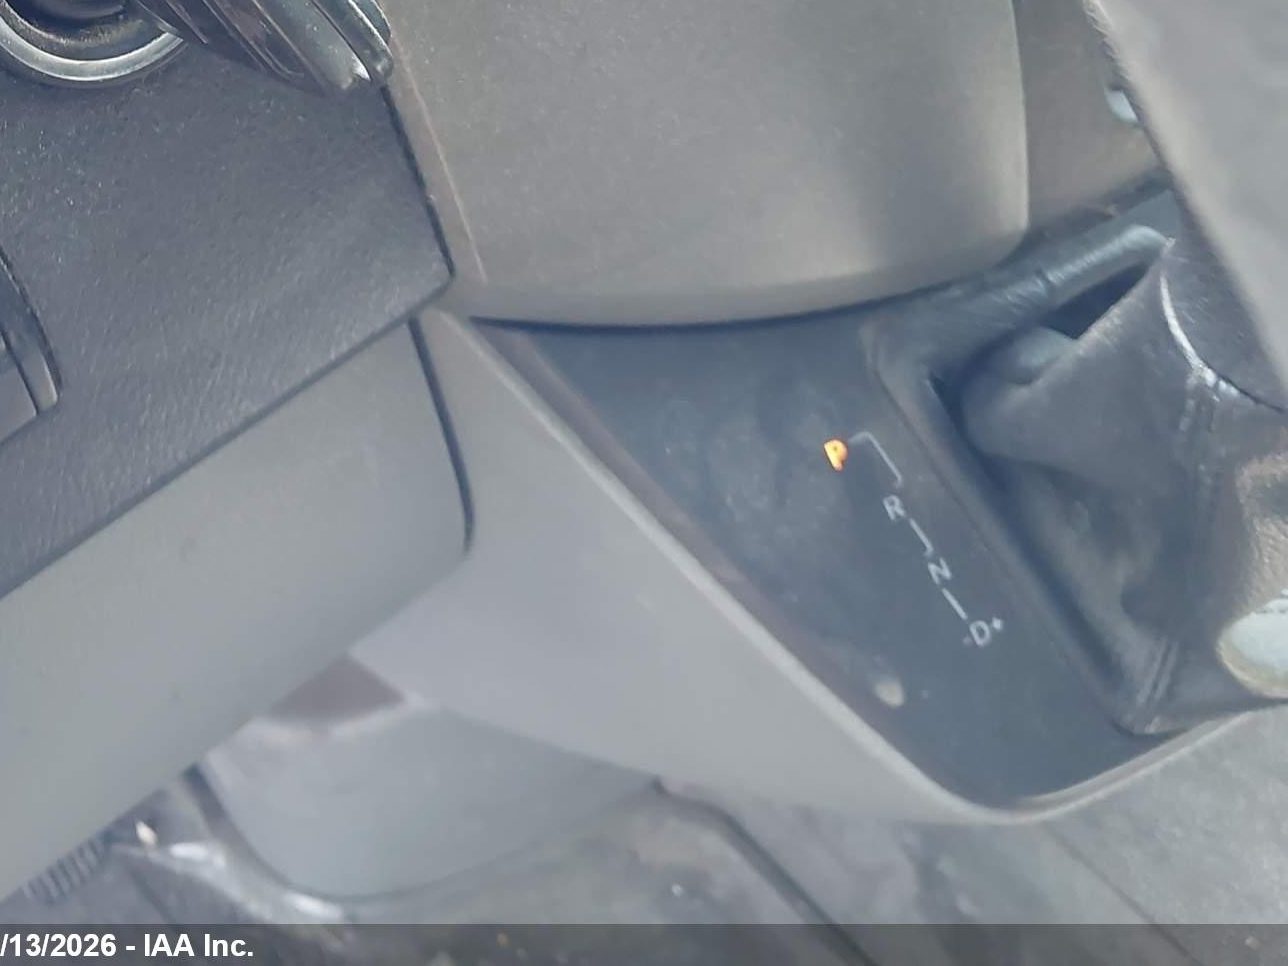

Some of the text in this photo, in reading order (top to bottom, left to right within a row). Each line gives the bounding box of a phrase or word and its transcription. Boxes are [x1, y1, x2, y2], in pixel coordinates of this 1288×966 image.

[823, 438, 849, 472] P
[882, 494, 906, 521] R
[927, 557, 953, 585] N
